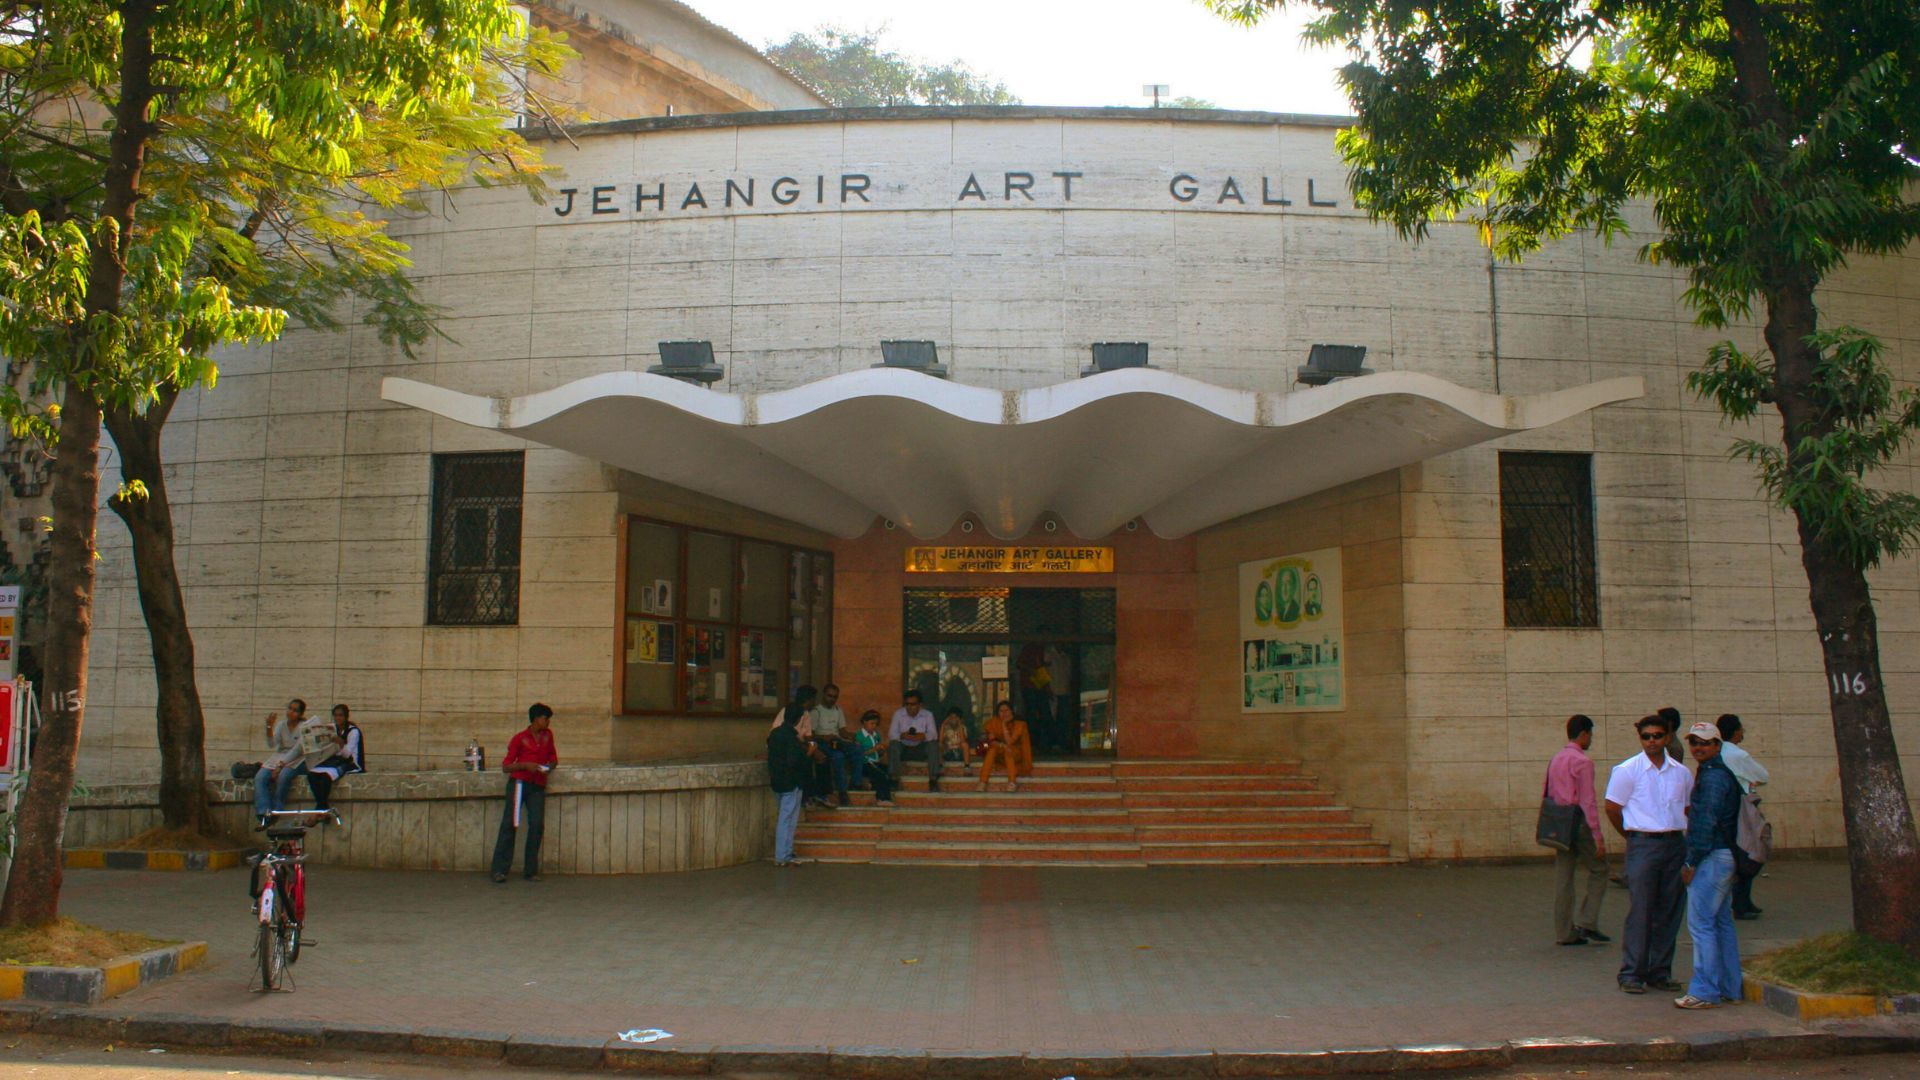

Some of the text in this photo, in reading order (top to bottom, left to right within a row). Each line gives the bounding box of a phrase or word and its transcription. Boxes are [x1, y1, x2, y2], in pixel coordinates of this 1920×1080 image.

[554, 171, 1338, 217] JEHANGIR ART GALL
[940, 549, 1103, 560] JEHANGIR ART GALLERY
[8, 594, 16, 602] BY
[1832, 672, 1867, 695] 116
[51, 689, 82, 712] 115
